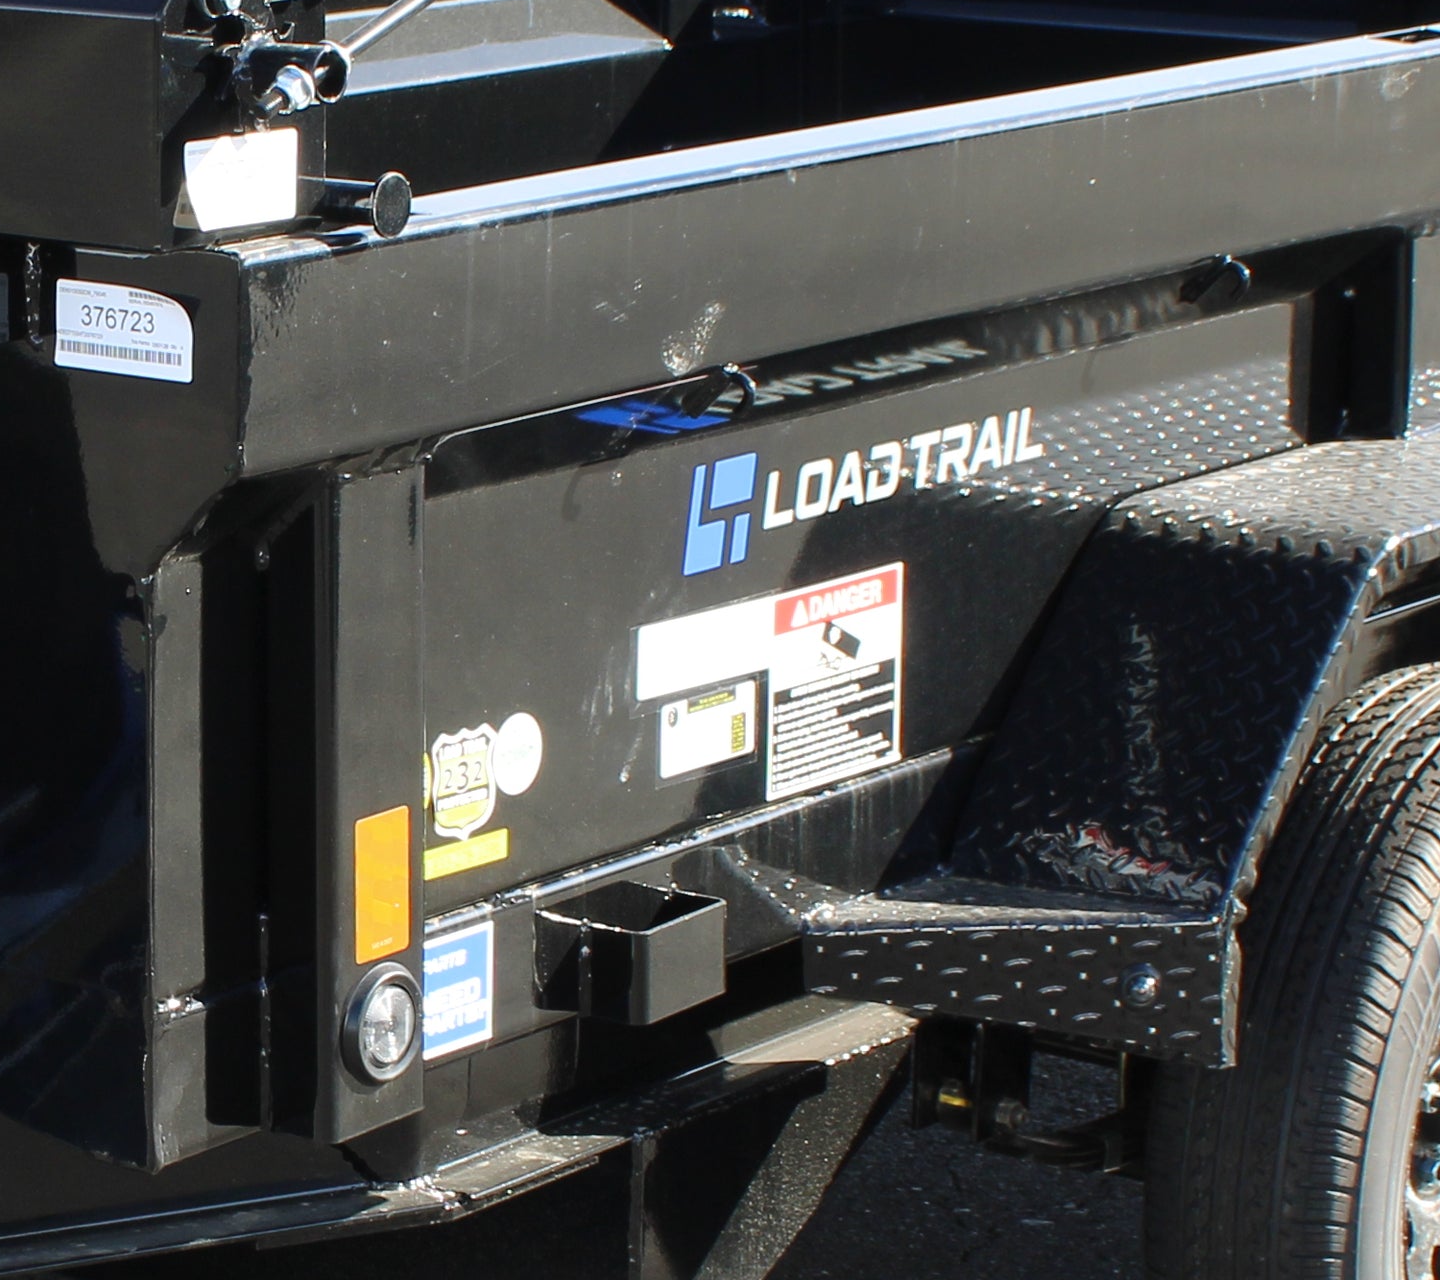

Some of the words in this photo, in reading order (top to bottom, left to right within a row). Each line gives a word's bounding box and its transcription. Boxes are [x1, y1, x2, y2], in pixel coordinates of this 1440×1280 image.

[80, 305, 156, 334] 376723
[761, 440, 904, 531] LOAD
[908, 406, 1046, 490] TRAIL
[808, 578, 883, 622] DANGER
[445, 761, 483, 791] 232
